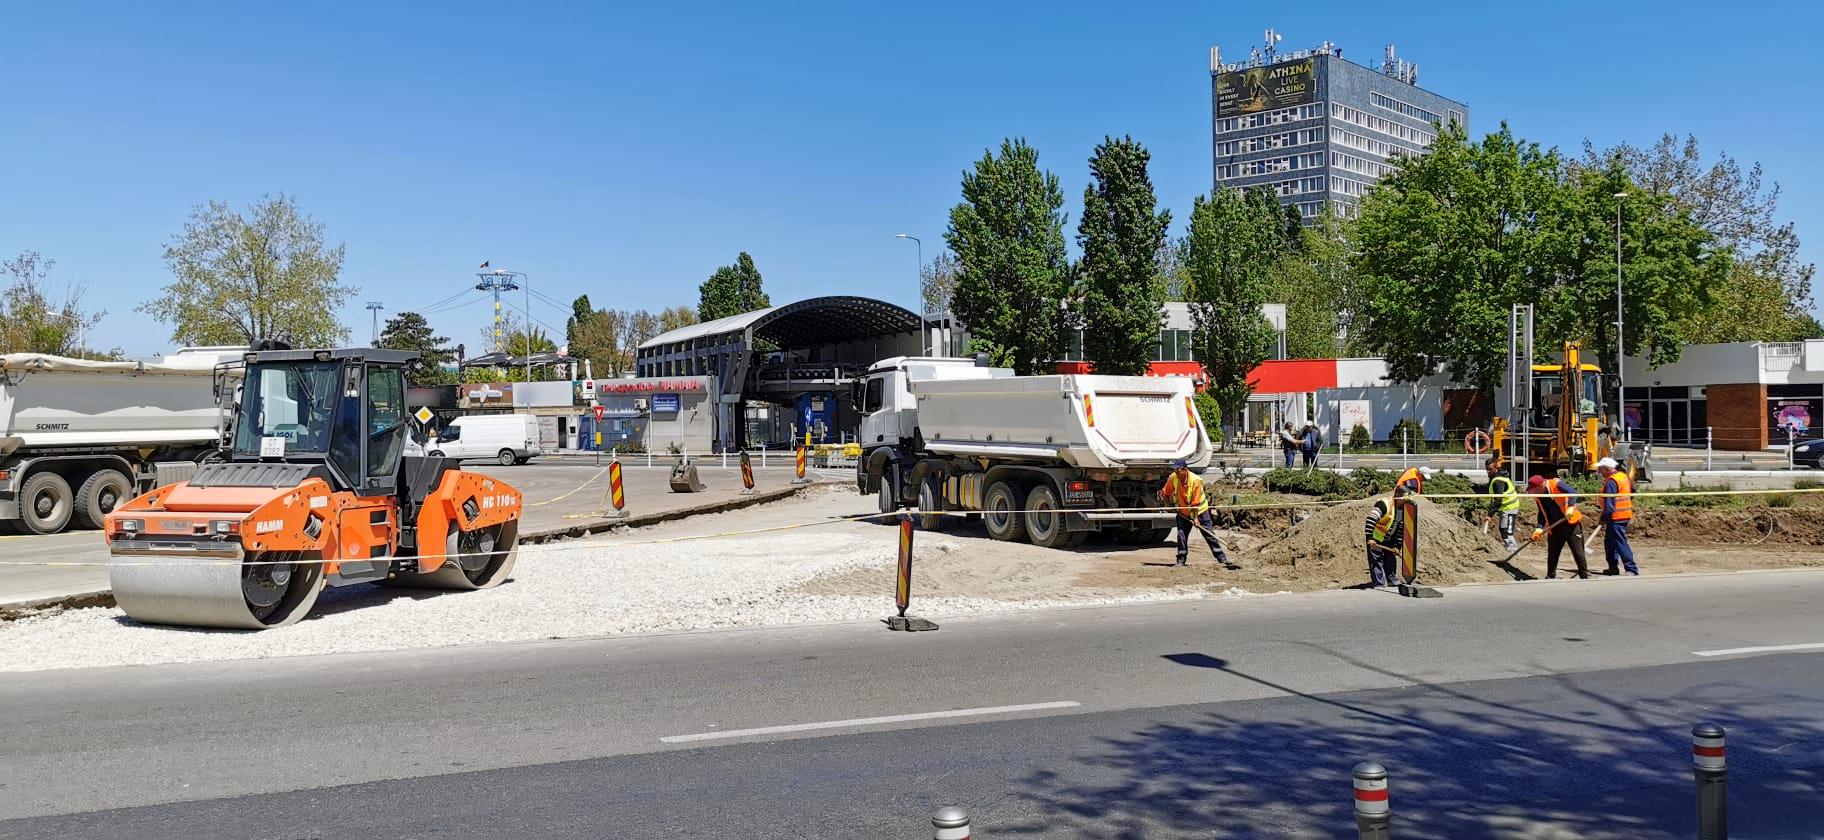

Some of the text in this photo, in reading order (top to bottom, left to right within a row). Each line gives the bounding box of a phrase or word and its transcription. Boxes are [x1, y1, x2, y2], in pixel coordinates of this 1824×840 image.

[1281, 76, 1299, 86] LIVE
[1274, 84, 1306, 95] CASINO
[256, 519, 284, 535] HAMM
